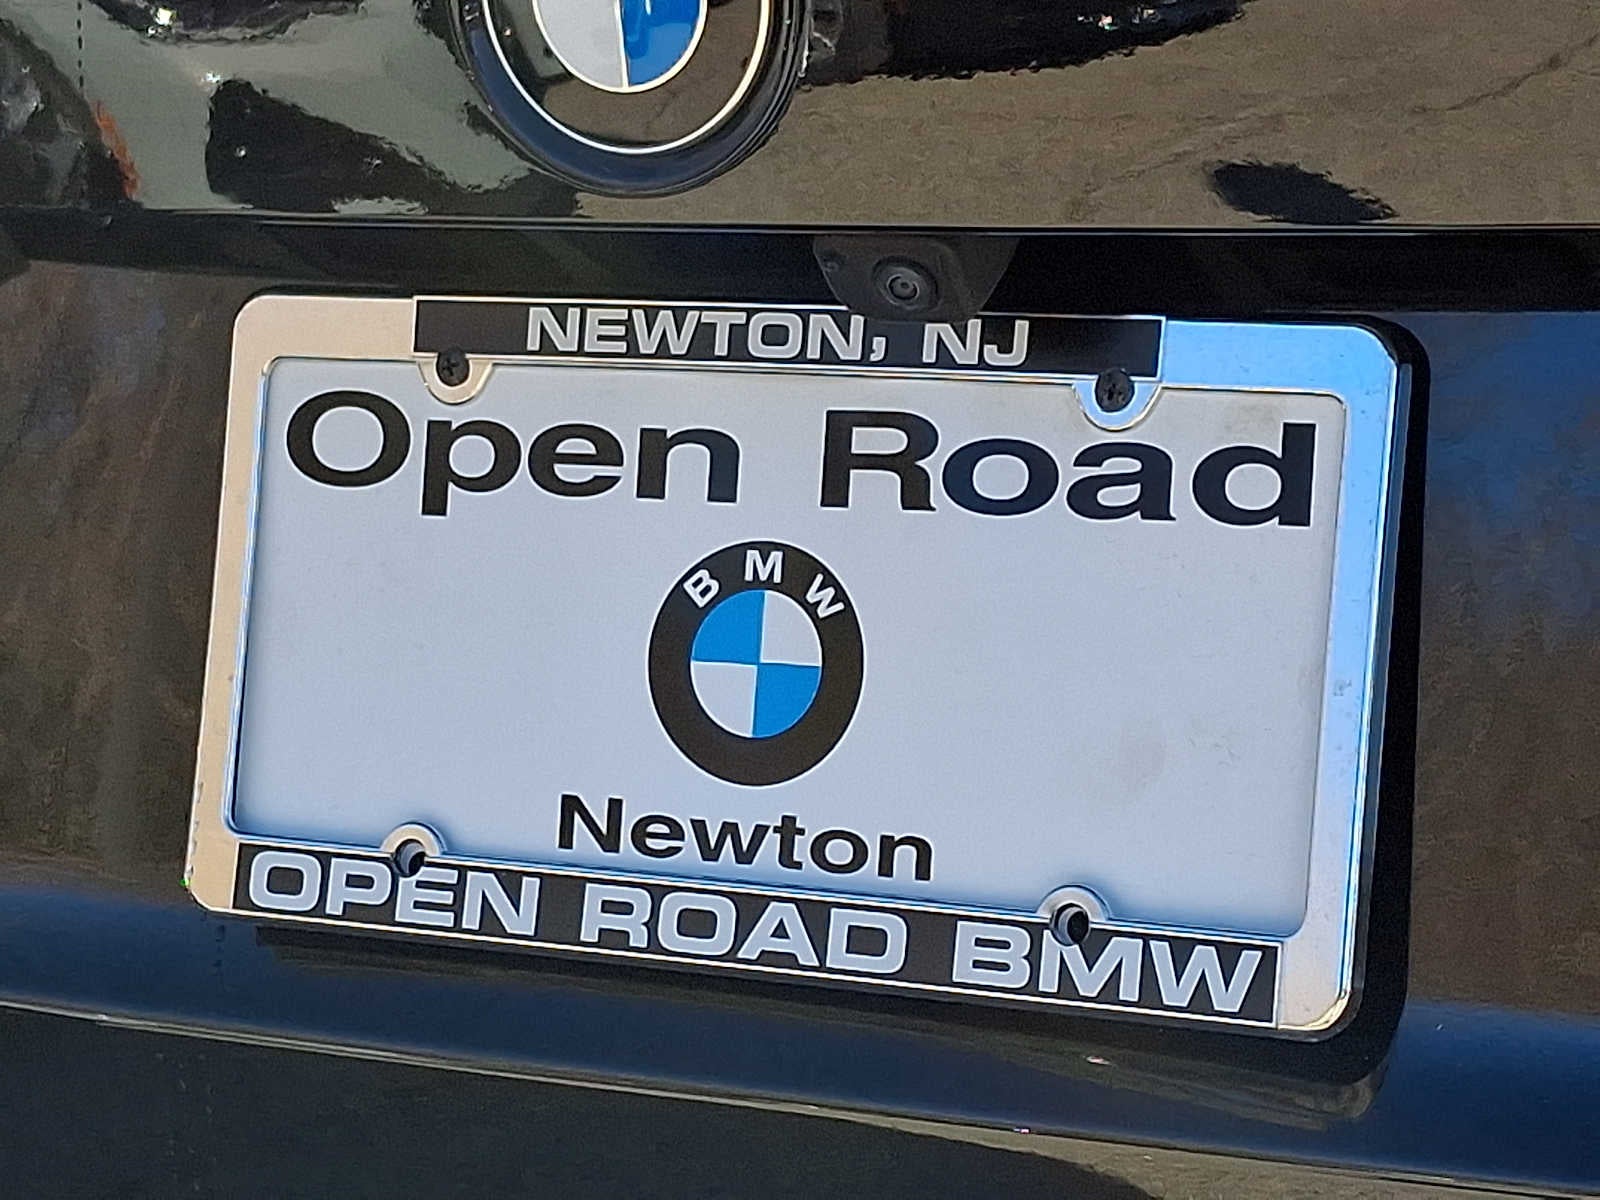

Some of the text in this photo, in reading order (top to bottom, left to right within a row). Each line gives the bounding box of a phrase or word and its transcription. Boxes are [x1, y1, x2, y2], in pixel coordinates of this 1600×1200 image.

[526, 306, 1030, 367] NEWTON, NJ
[286, 390, 1317, 528] Open Road
[682, 549, 845, 619] BMW
[557, 793, 934, 881] Newton
[248, 850, 1263, 1013] OPEN ROAD BMW
